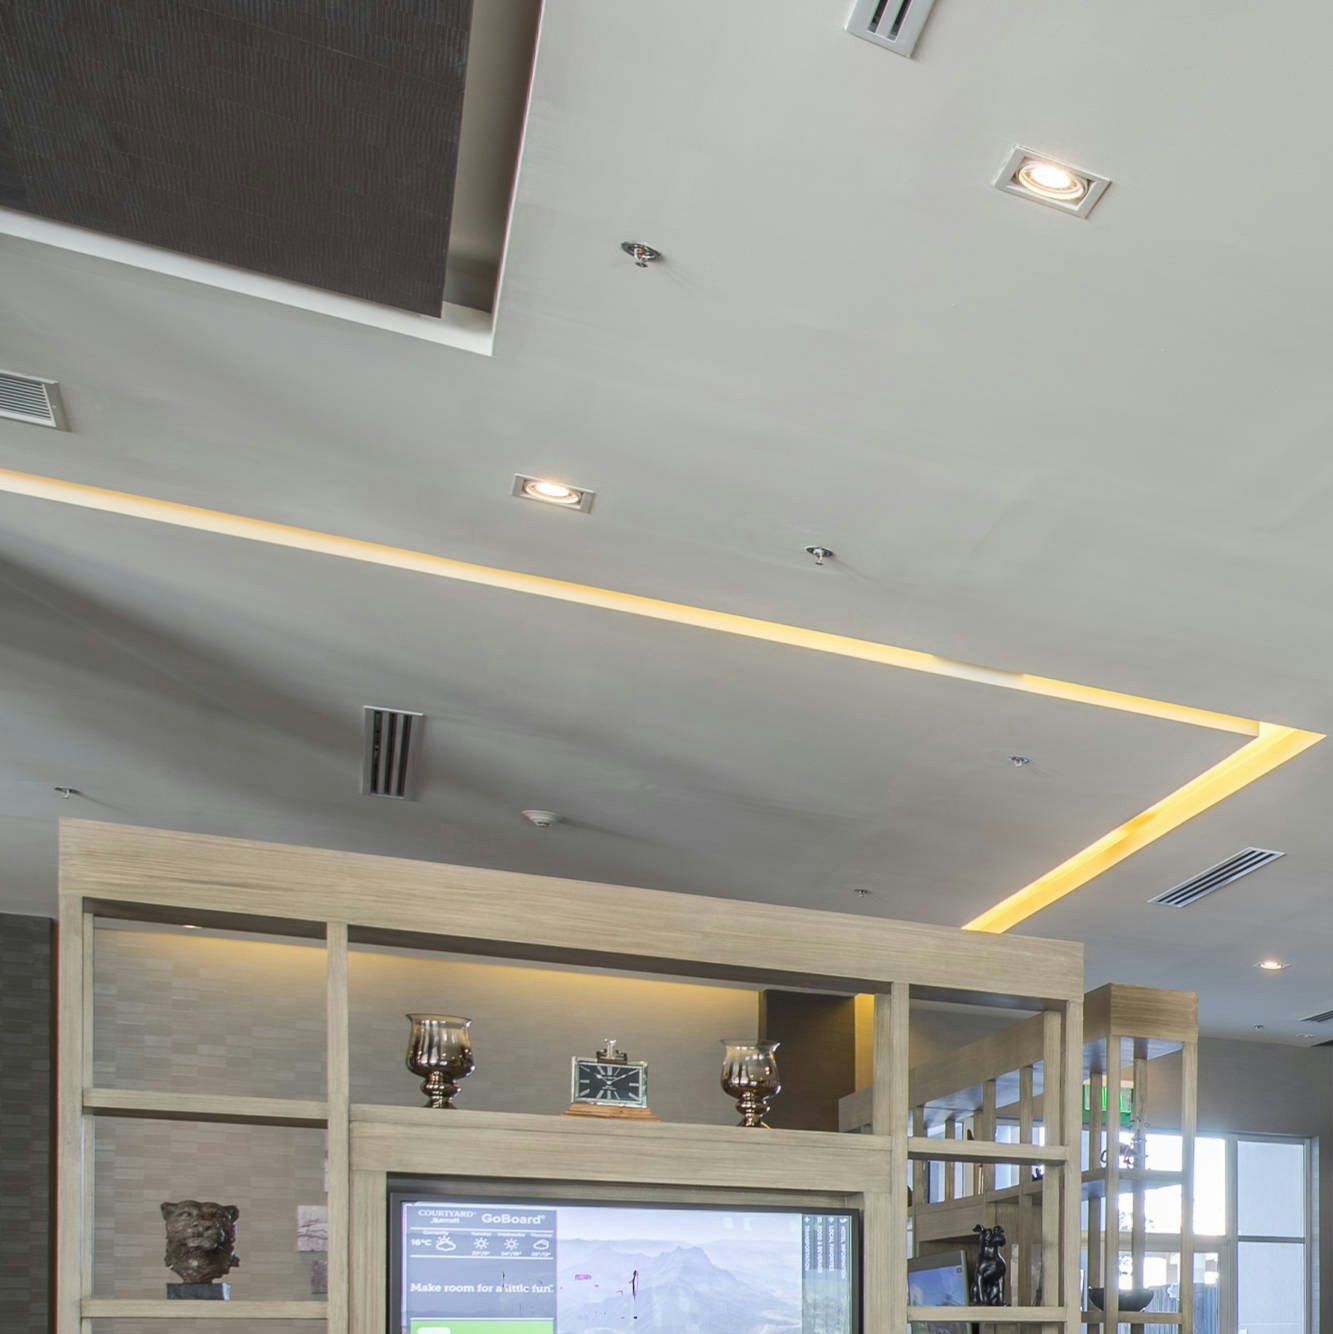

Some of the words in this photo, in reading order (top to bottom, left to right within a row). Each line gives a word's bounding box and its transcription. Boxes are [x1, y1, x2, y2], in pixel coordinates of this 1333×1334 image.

[410, 1282, 441, 1293] Make
[444, 1283, 474, 1293] room
[477, 1282, 493, 1293] for
[495, 1284, 503, 1293] a
